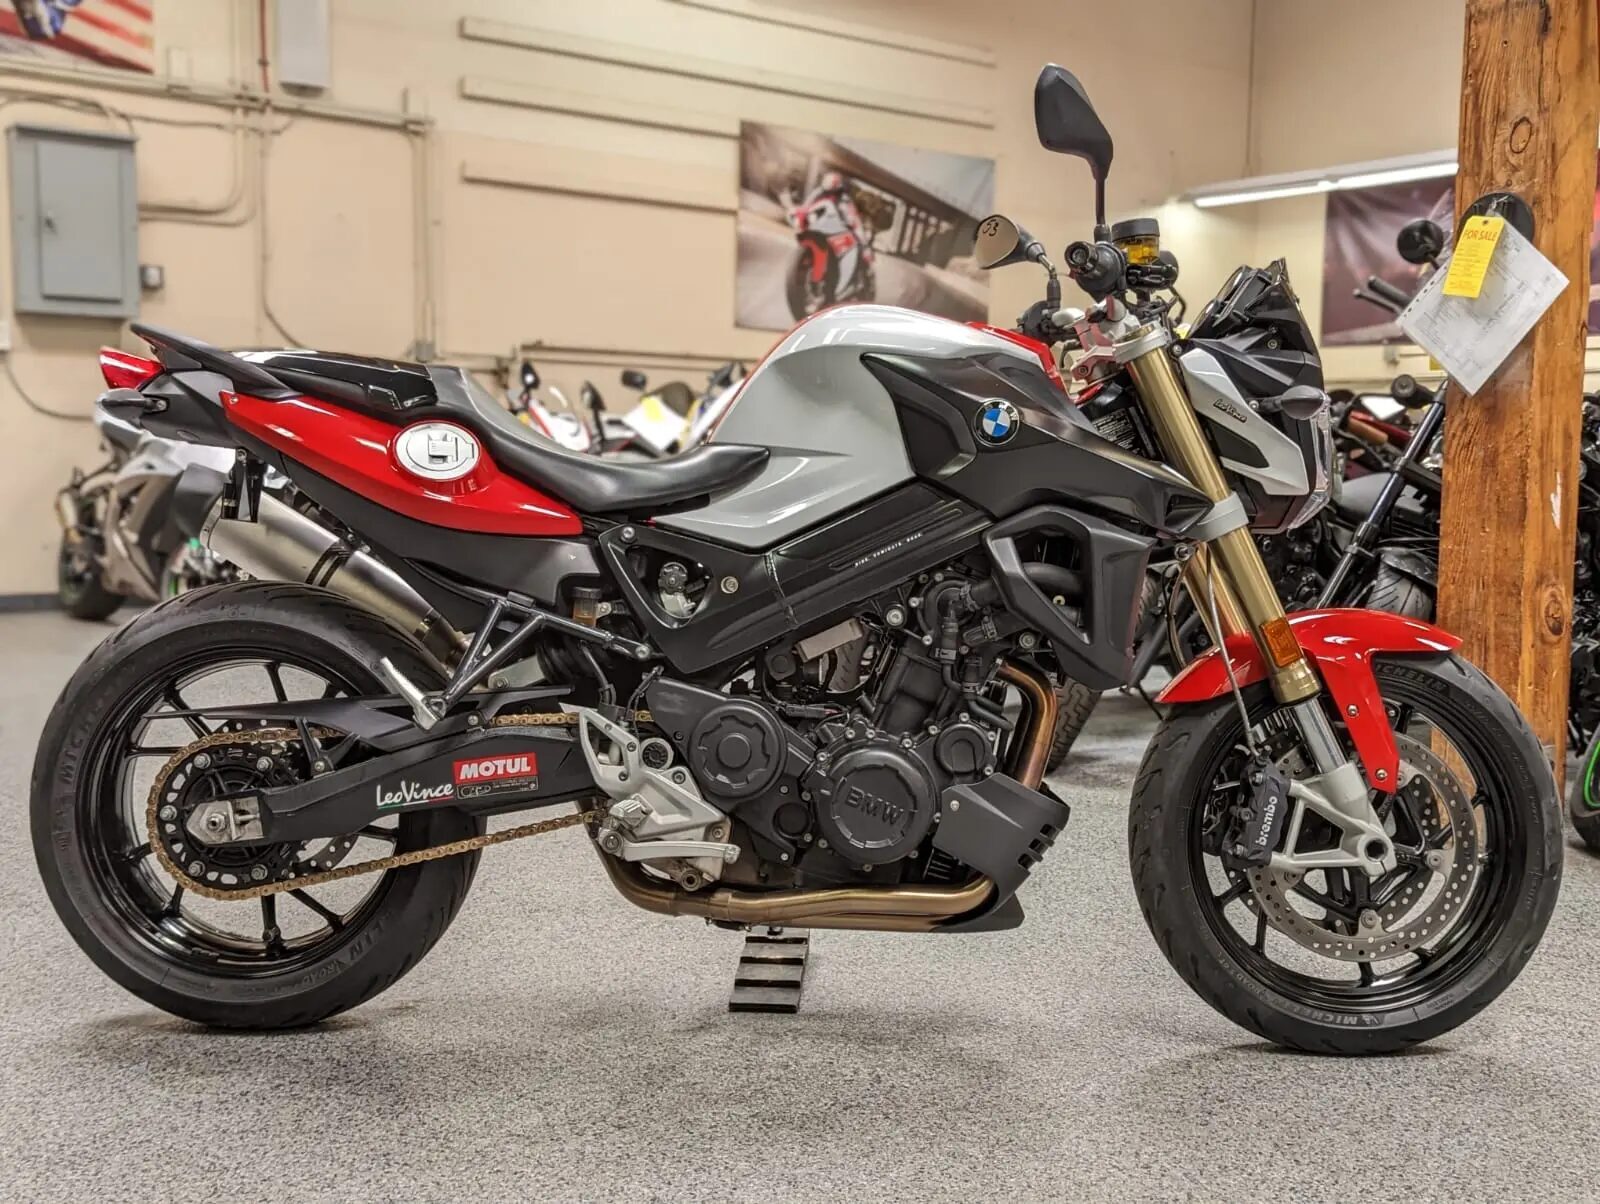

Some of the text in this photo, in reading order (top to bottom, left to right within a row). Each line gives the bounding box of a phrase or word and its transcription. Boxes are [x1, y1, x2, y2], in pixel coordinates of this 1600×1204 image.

[1464, 229, 1498, 242] FOR SALE
[1376, 664, 1447, 693] ICHELIN
[460, 757, 531, 780] MOTUL
[376, 780, 454, 806] LeoVince
[847, 785, 905, 825] BMW
[1255, 796, 1278, 846] brembo
